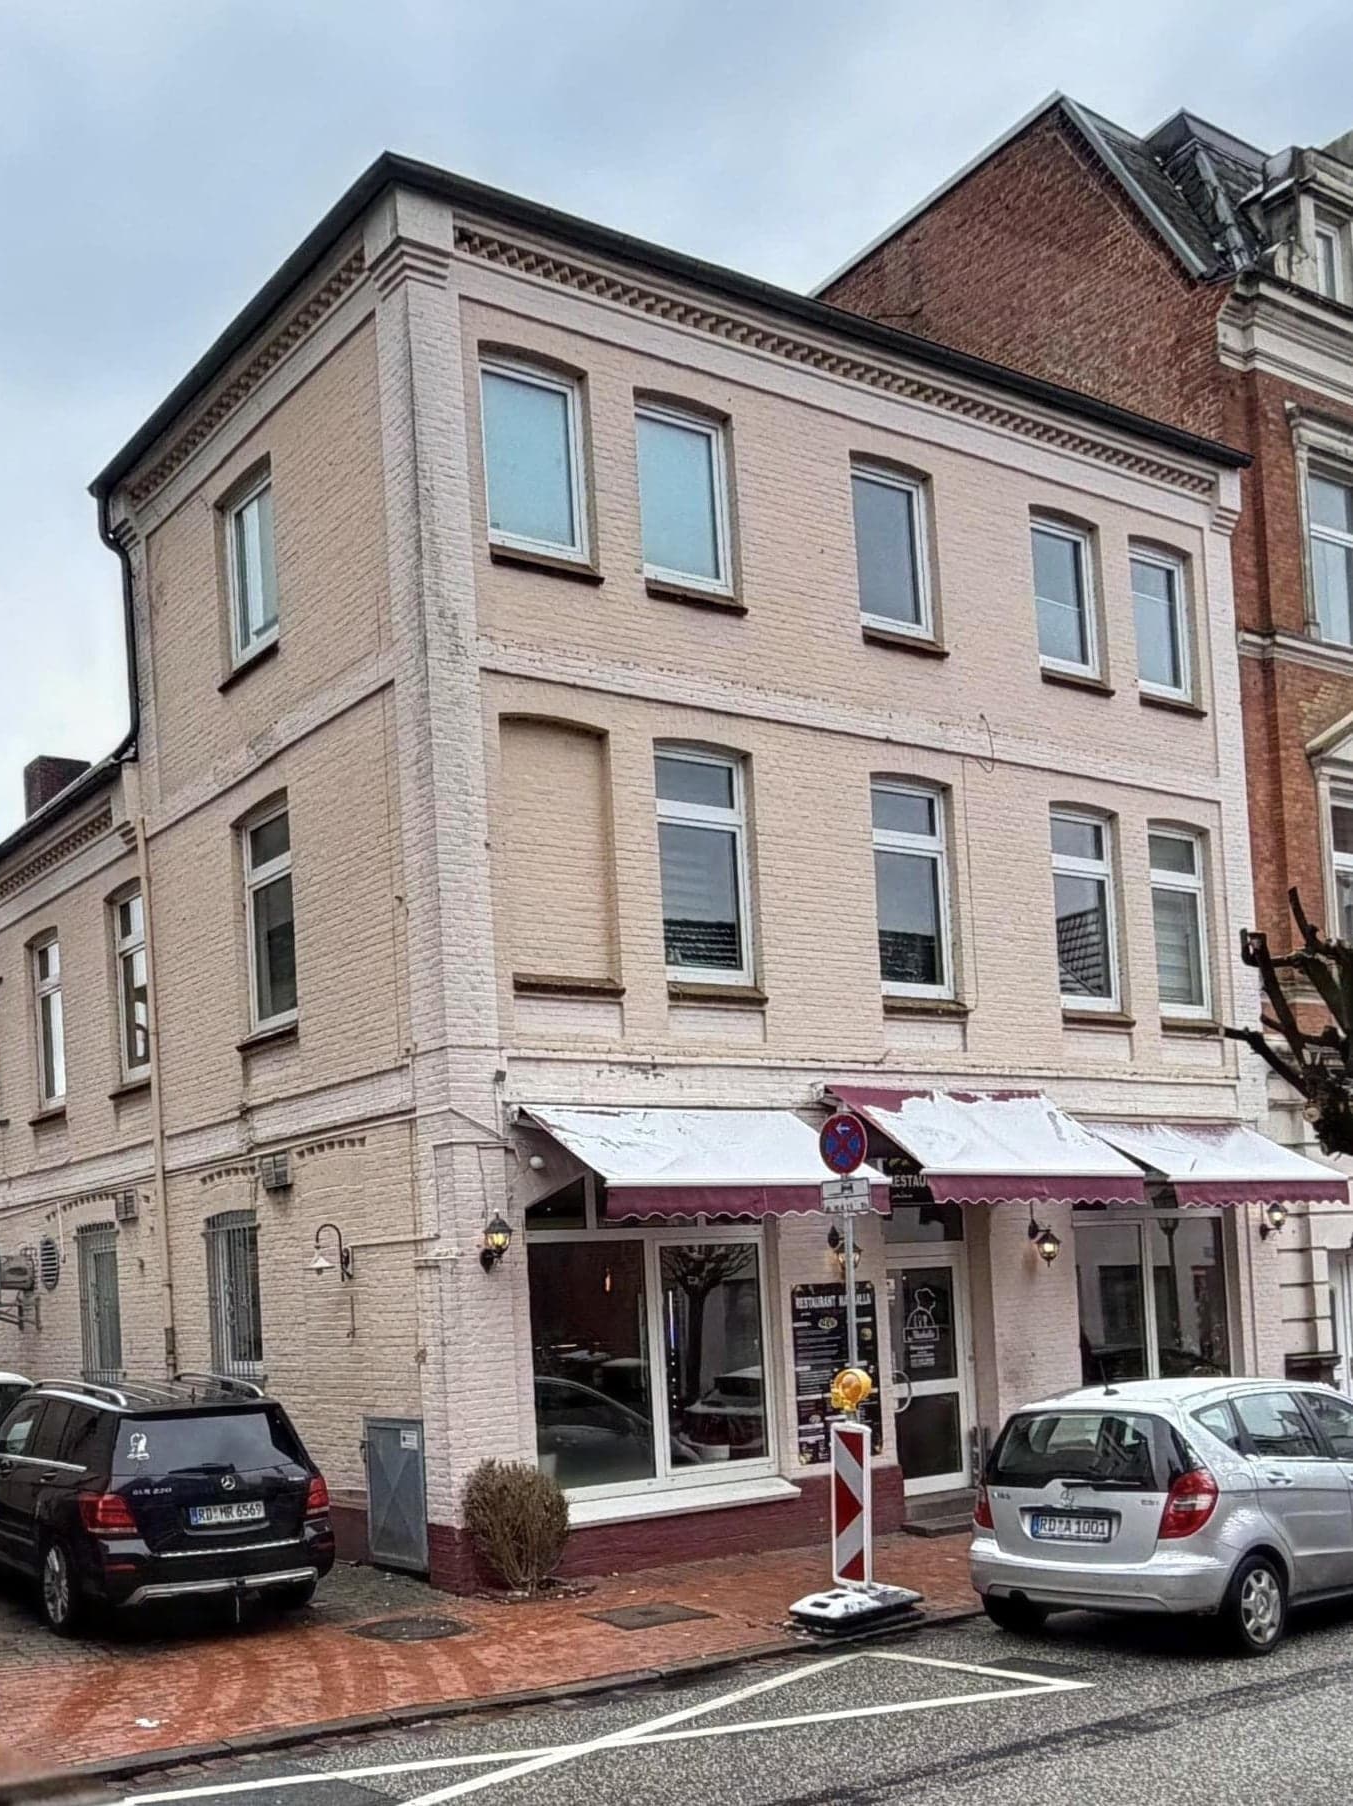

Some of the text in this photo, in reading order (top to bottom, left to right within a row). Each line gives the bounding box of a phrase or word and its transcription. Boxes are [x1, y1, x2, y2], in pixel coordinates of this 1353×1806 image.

[198, 1507, 213, 1521] RD
[236, 1502, 262, 1518] 6569
[1040, 1518, 1106, 1535] RD A 1001
